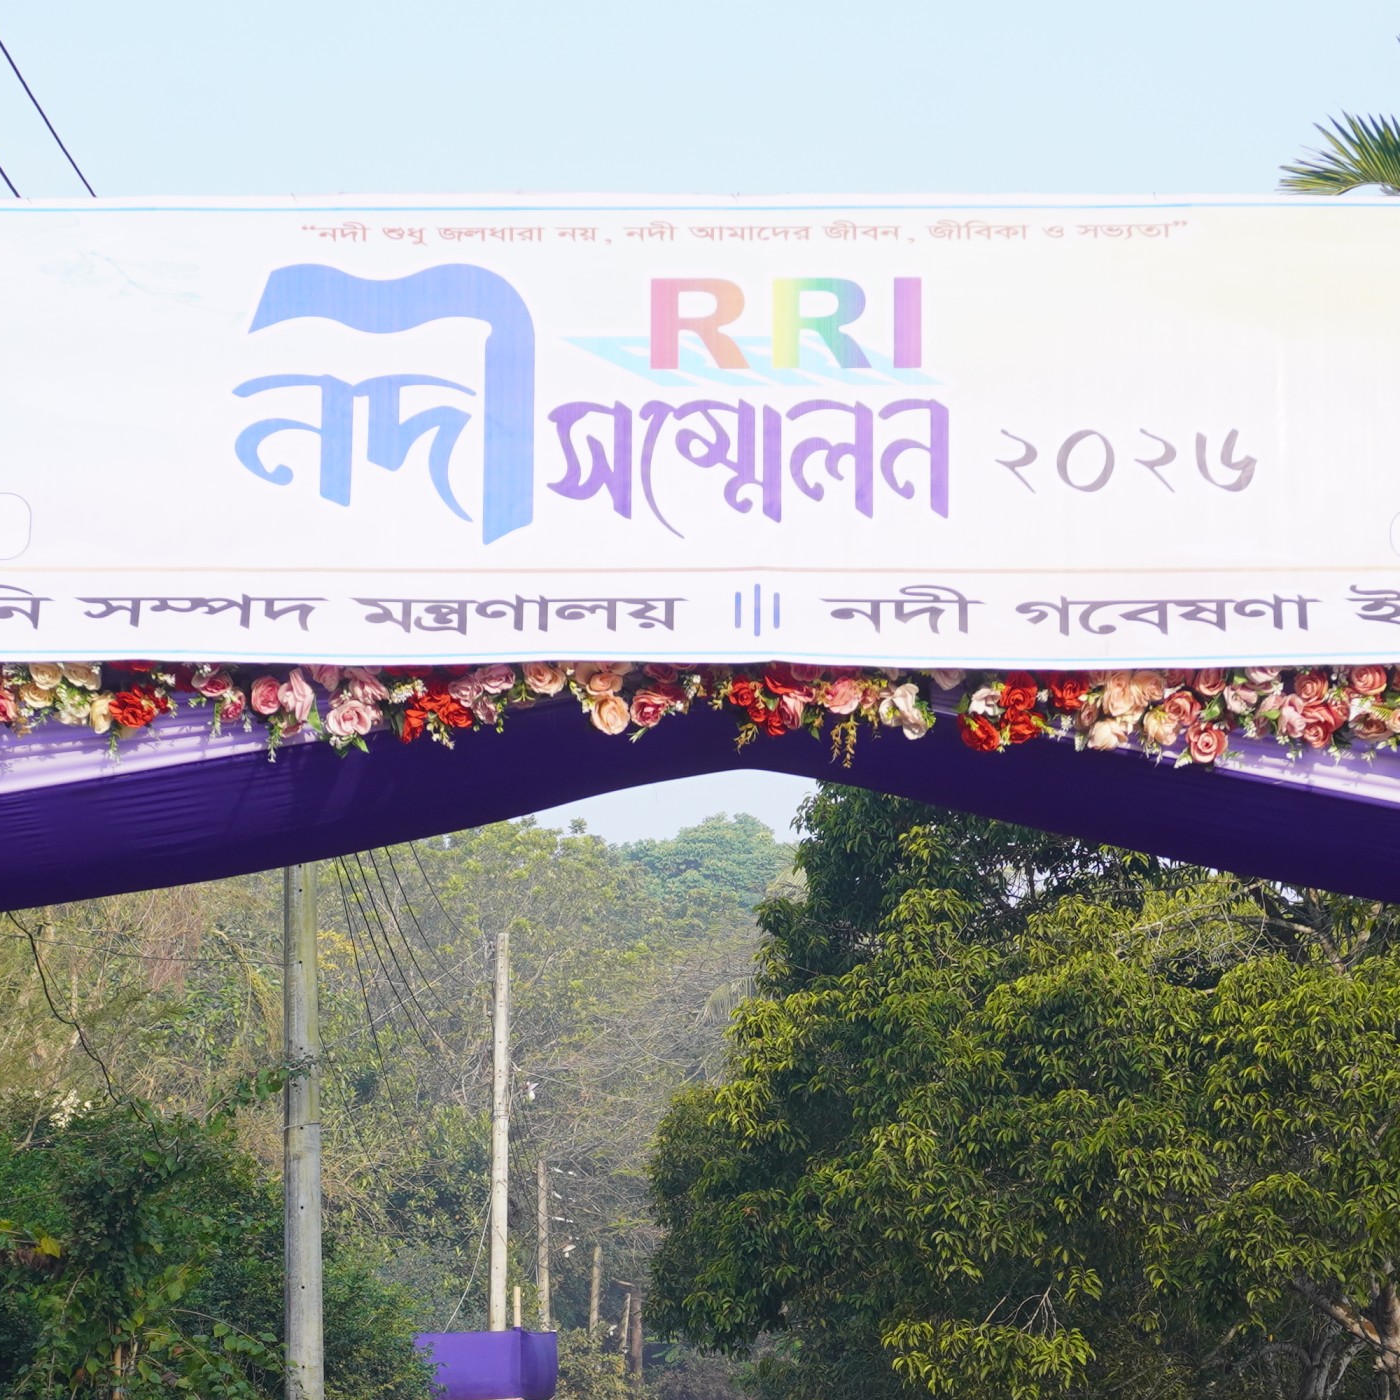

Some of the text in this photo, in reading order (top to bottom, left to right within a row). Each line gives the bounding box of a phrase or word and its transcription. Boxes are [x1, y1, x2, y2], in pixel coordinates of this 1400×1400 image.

[383, 227, 428, 247] শুধু
[437, 227, 545, 243] জলধারা
[624, 222, 678, 243] নদী
[689, 226, 812, 243] আমাদের
[928, 221, 1031, 241] জীবিকা
[1042, 226, 1066, 239] ও
[649, 276, 923, 370] RRI
[232, 263, 1258, 546] নদী সম্মেলন ২০২৬
[74, 593, 330, 633] সম্পদ
[349, 594, 690, 637] মন্ত্রণালয়
[819, 584, 987, 636] নদী
[1015, 593, 1323, 637] গবেষণা
